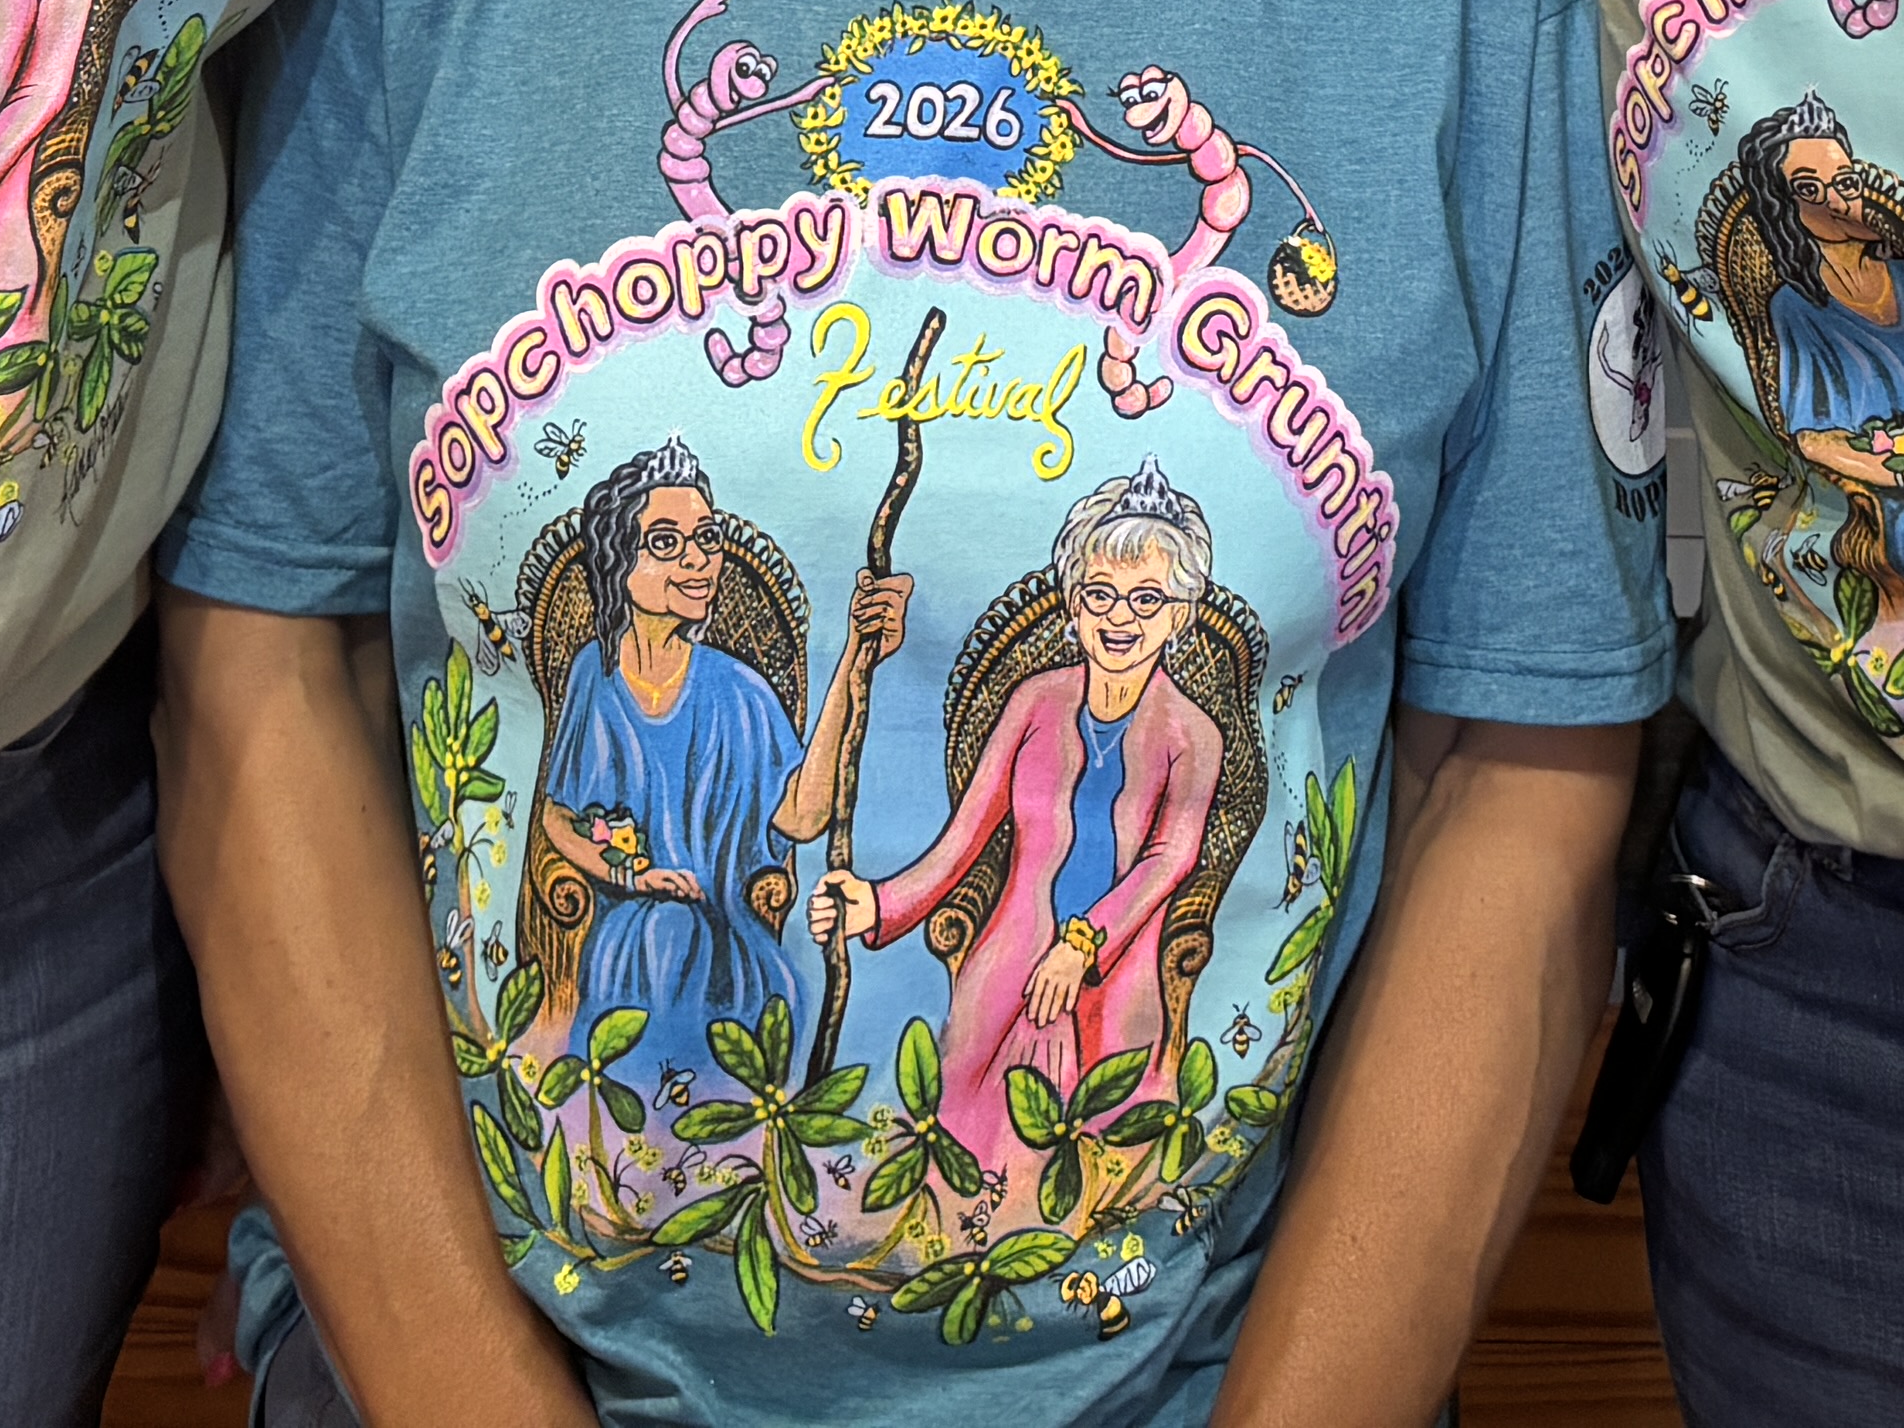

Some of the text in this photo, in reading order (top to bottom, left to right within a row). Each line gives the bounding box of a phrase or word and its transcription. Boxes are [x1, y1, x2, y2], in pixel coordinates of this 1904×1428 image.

[863, 80, 1023, 150] 2026
[414, 200, 847, 534] Sopchoppy
[889, 190, 1156, 327] Worm
[802, 301, 1086, 482] Festival
